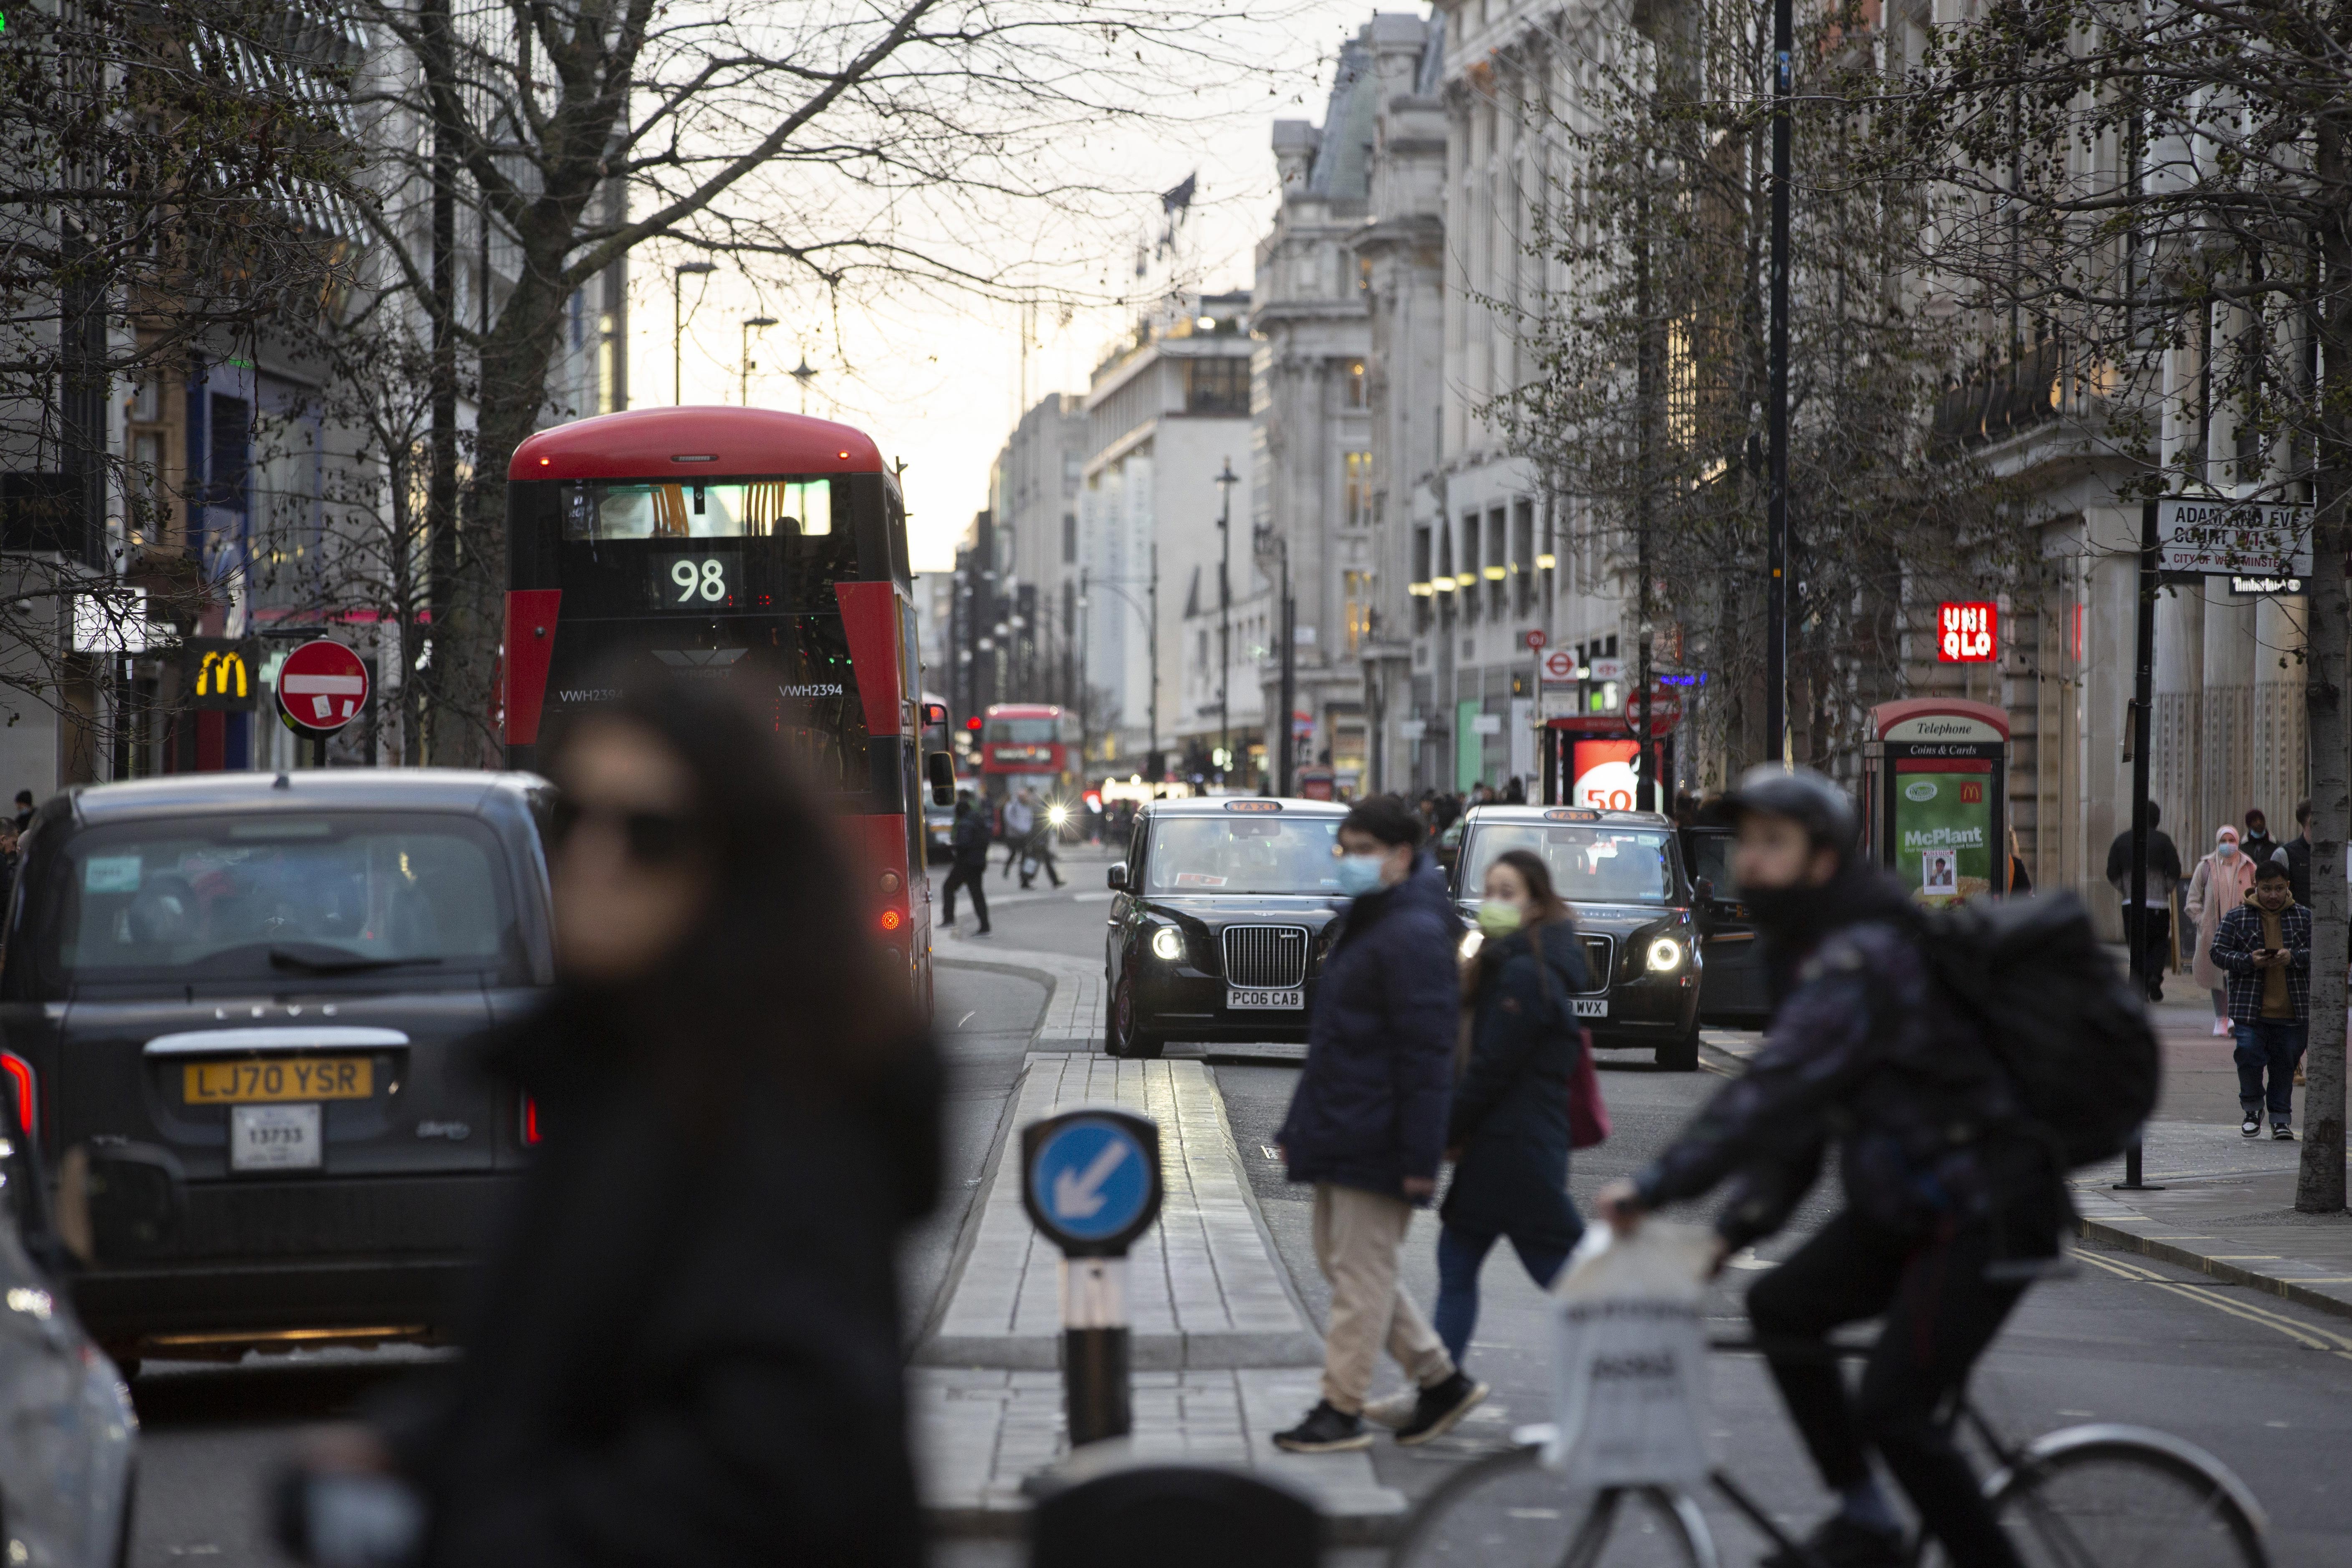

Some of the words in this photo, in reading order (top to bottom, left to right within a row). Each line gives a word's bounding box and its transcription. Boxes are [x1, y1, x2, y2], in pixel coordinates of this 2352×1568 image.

[2175, 507, 2222, 524] ADAM
[2271, 512, 2299, 528] EVE
[2175, 527, 2229, 545] COURT
[2174, 553, 2196, 564] CITY
[2198, 555, 2211, 564] OF
[2215, 555, 2287, 568] WETMINSTE
[671, 559, 726, 602] 98
[1943, 607, 1987, 633] UNI
[1943, 631, 1991, 660] QLO
[778, 684, 843, 697] VWH2394
[1917, 722, 1972, 736] Telephone
[1910, 744, 1937, 755] Coins
[1938, 745, 1947, 755] &
[1949, 745, 1977, 755] Cards
[1552, 811, 1591, 820] TAXI
[1905, 826, 1982, 847] McPlant
[1233, 992, 1268, 1005] PC06
[1272, 992, 1299, 1005] CAB
[1577, 1001, 1602, 1014] WVX
[197, 1065, 284, 1097] LJ70
[294, 1063, 358, 1093] YSR
